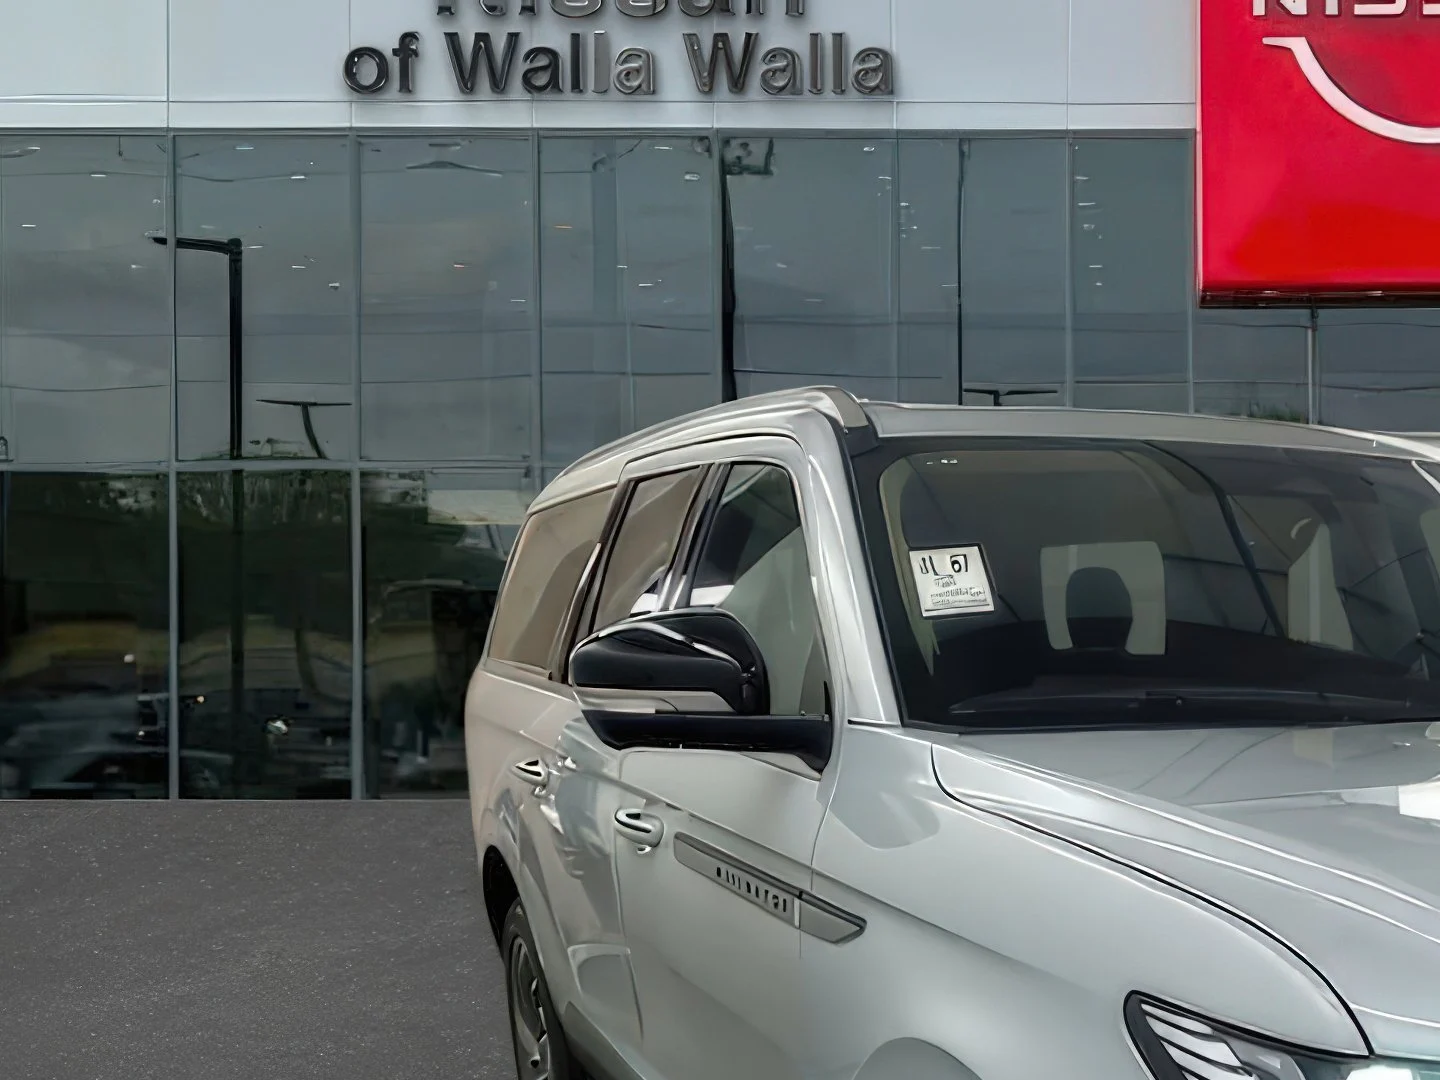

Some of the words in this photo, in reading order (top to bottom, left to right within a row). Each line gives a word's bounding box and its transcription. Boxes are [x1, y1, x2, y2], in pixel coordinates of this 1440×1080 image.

[341, 31, 422, 95] of
[442, 31, 656, 96] Walla
[681, 31, 895, 96] Walla
